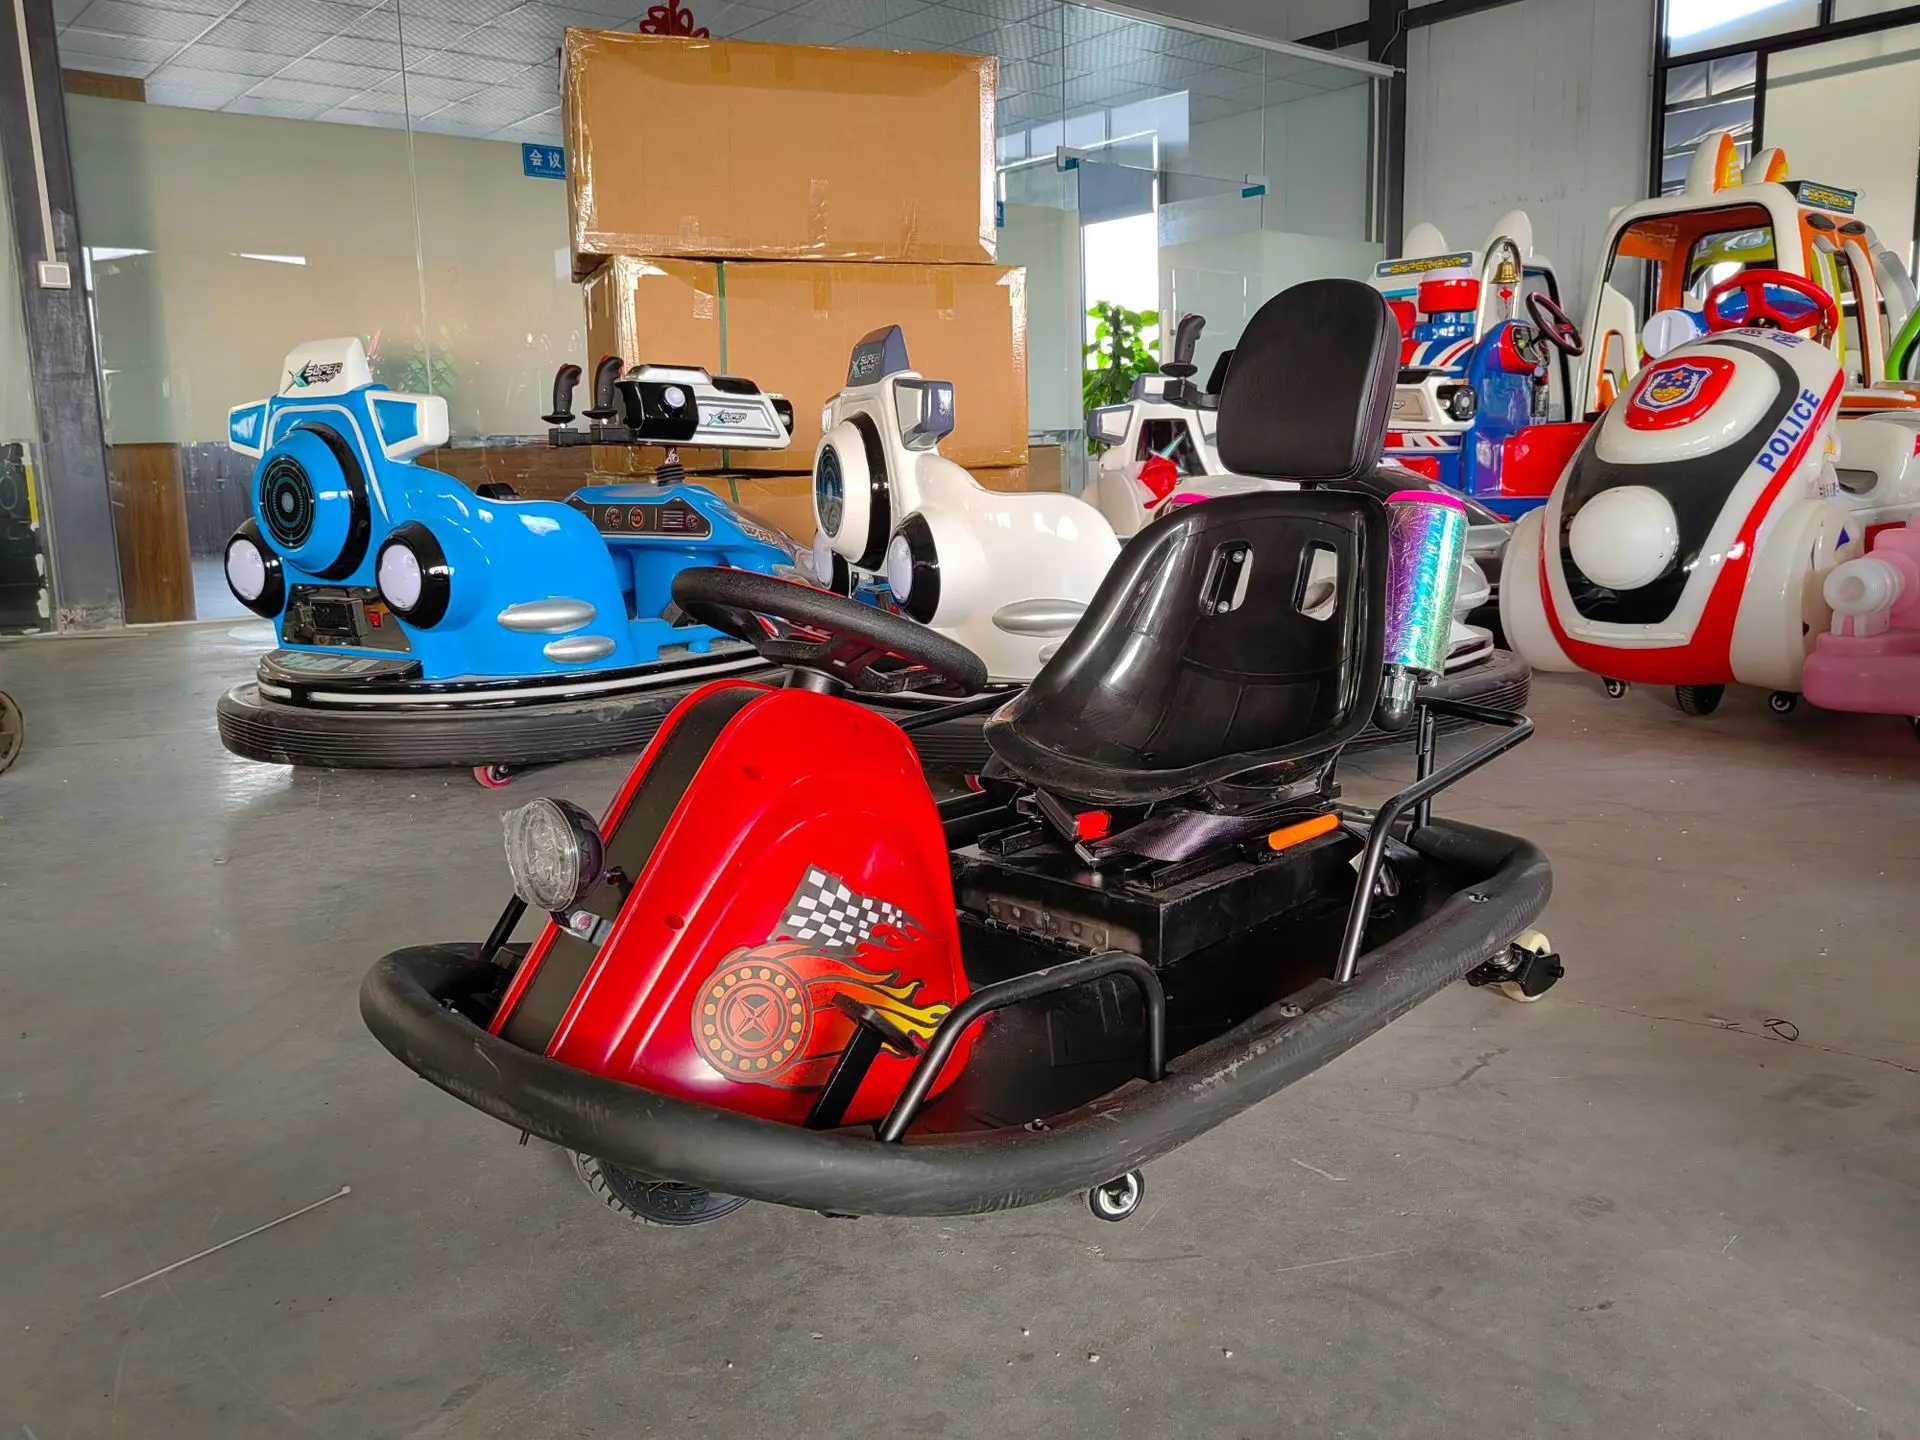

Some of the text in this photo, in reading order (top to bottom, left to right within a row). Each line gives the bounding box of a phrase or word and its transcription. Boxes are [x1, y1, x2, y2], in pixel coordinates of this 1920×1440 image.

[529, 149, 562, 169] 会议
[305, 362, 343, 376] SUPER
[1757, 389, 1821, 473] POLICE
